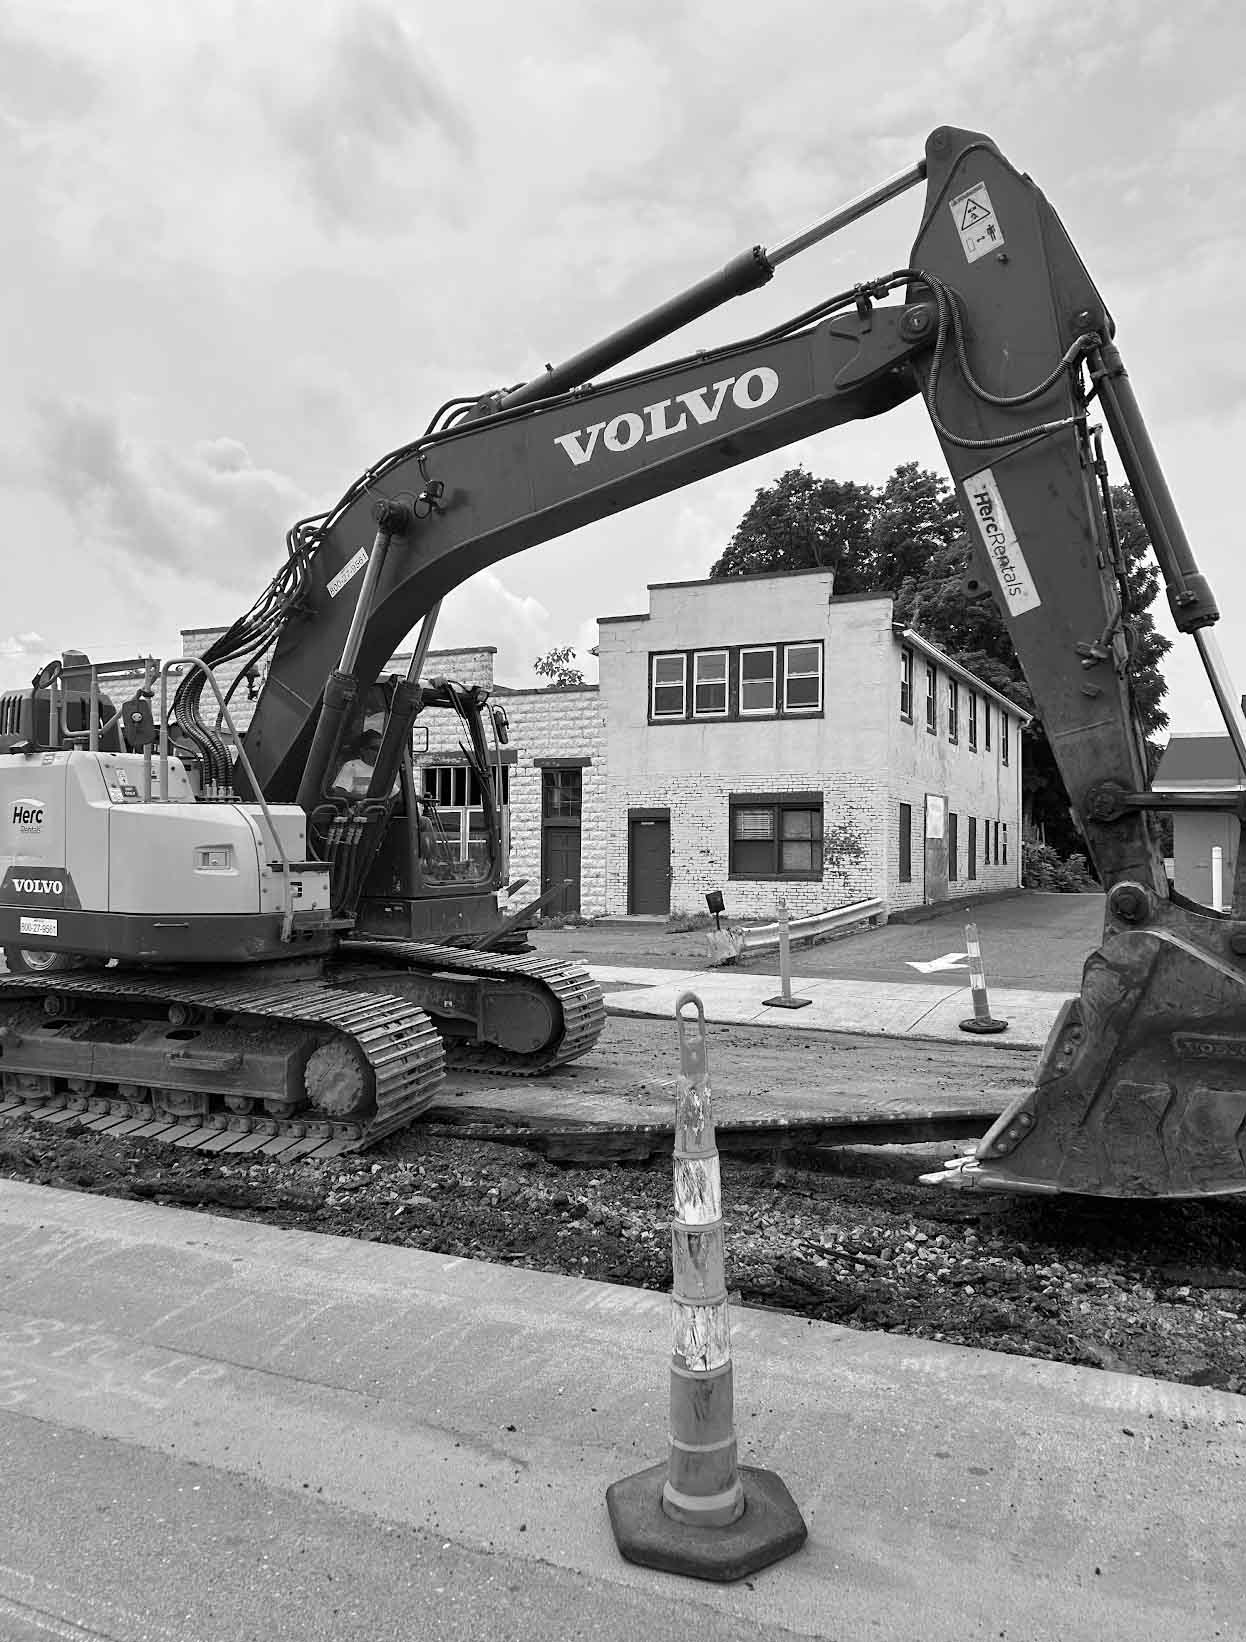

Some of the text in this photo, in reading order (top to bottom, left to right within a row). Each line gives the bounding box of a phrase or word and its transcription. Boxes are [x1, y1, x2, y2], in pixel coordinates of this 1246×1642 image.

[553, 366, 780, 466] VOLVO
[12, 806, 44, 824] Herc
[11, 878, 63, 894] VOLVO
